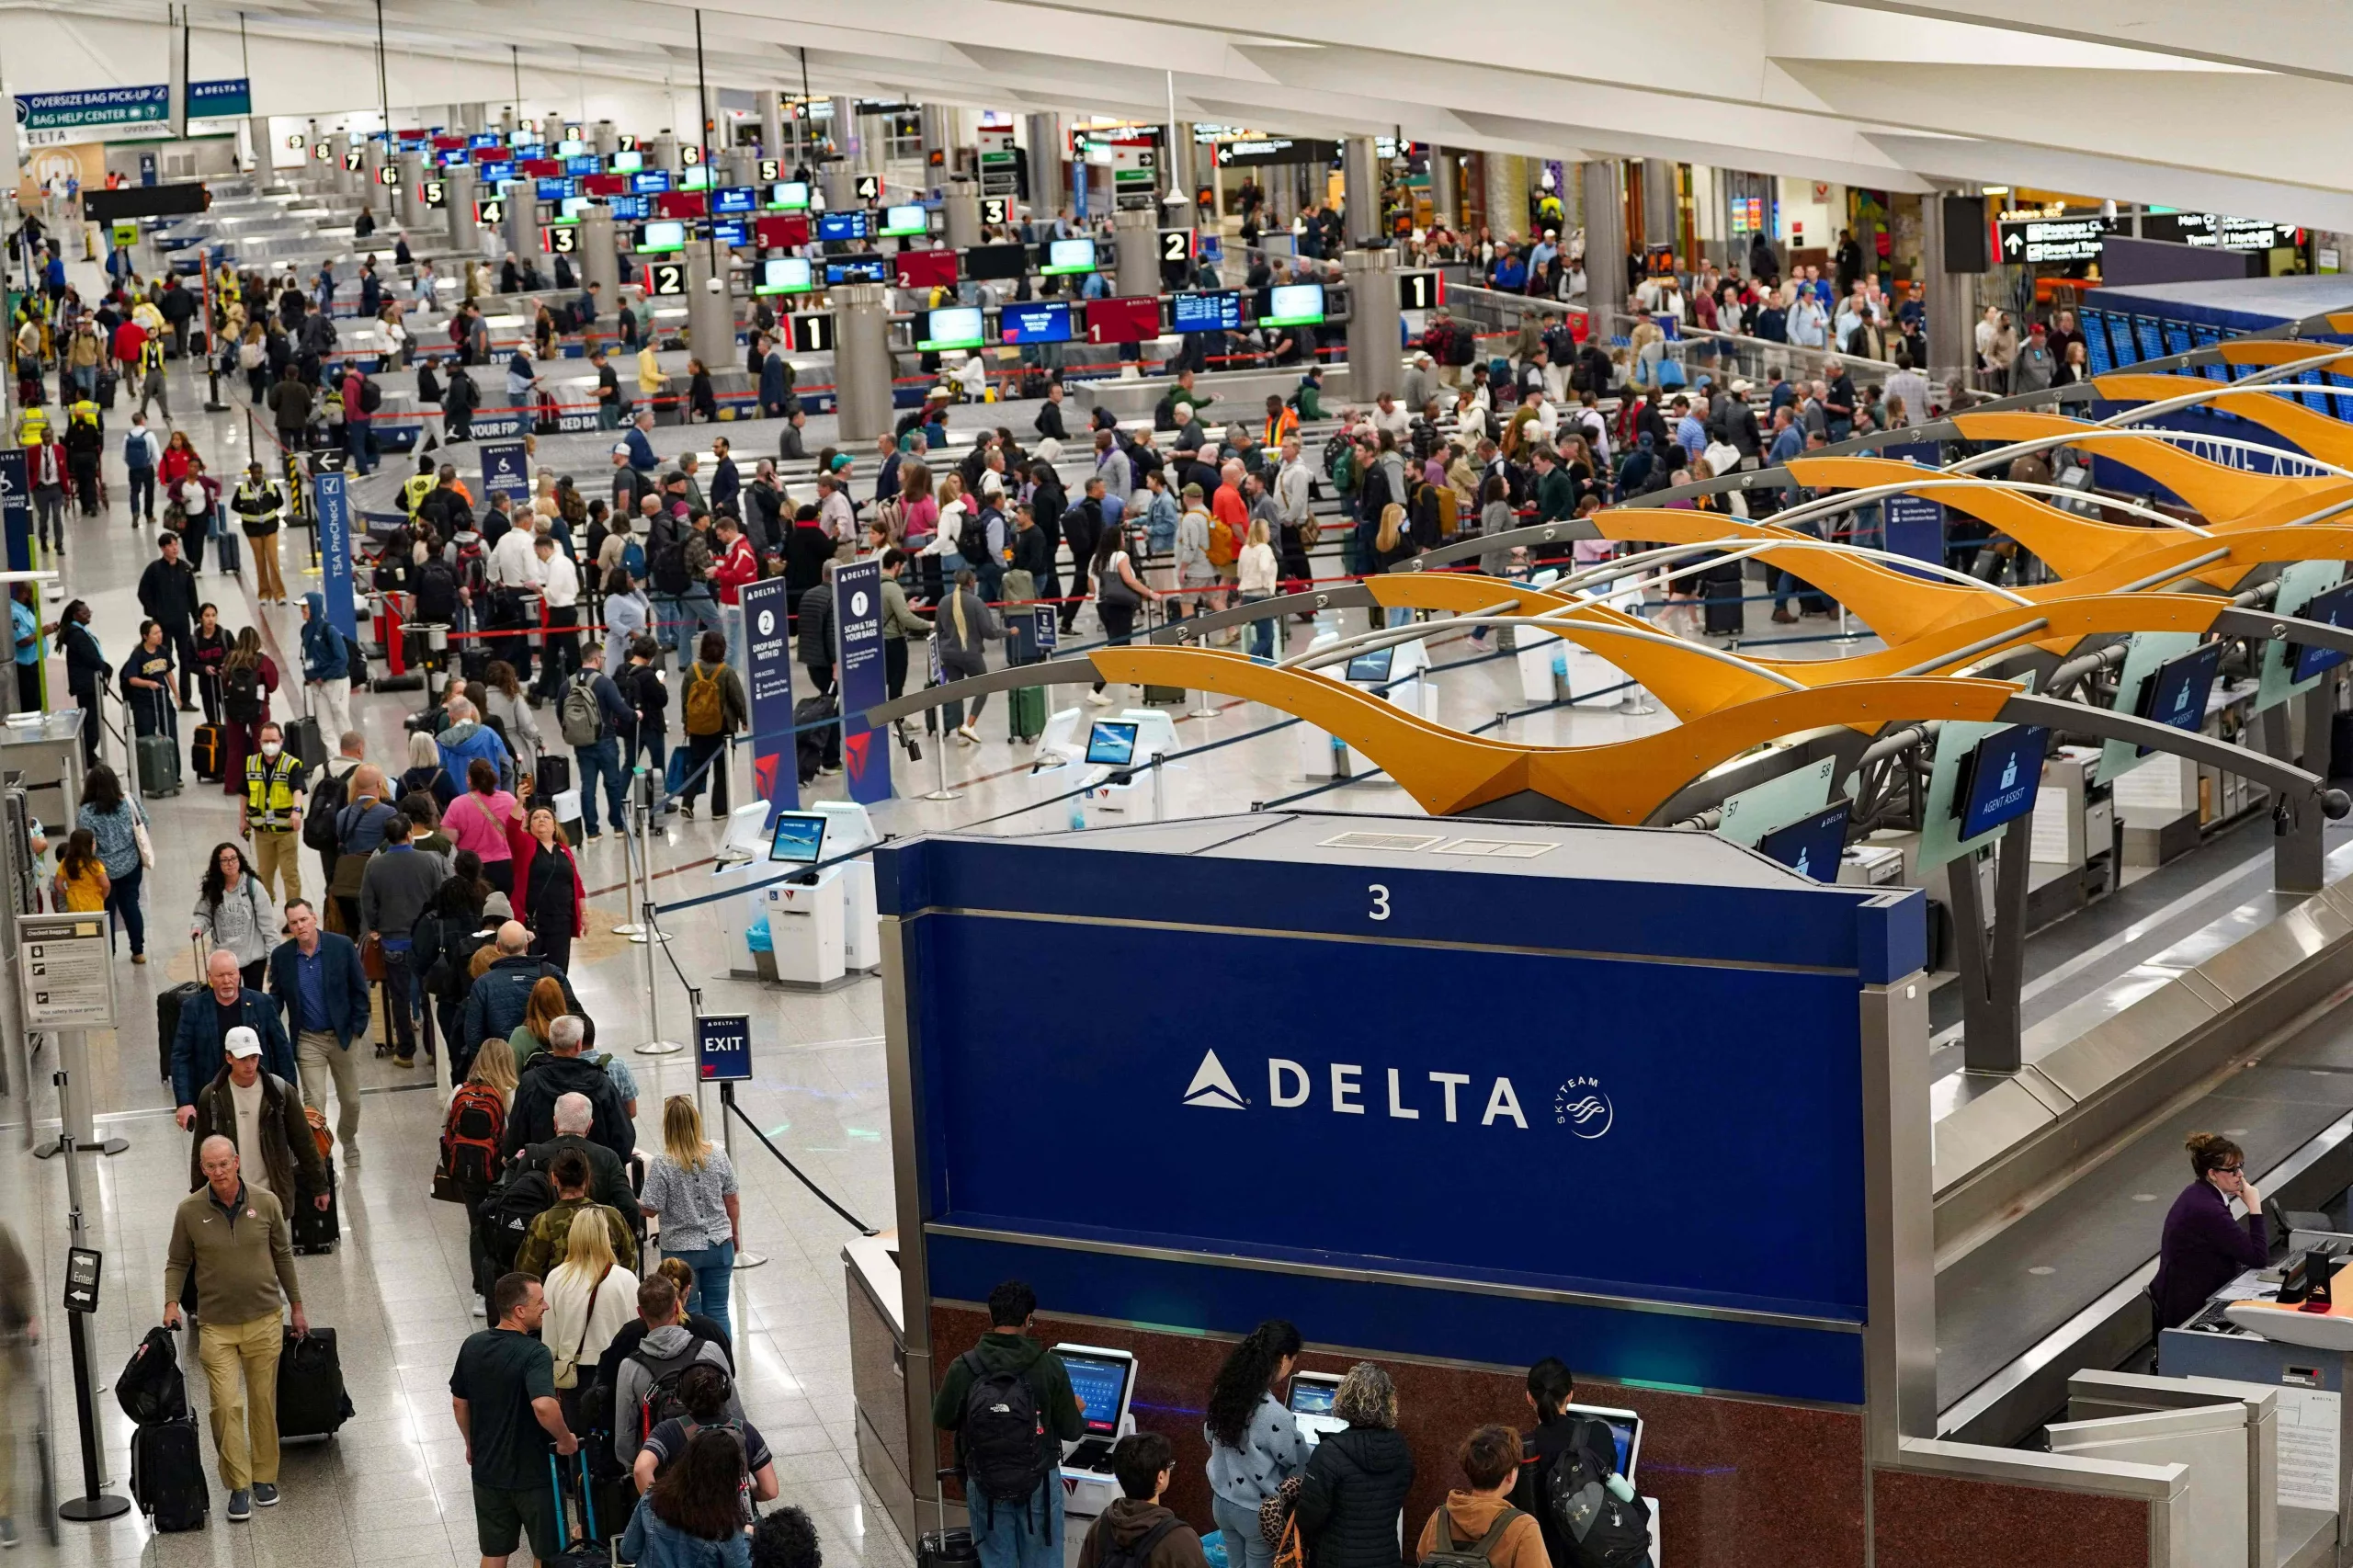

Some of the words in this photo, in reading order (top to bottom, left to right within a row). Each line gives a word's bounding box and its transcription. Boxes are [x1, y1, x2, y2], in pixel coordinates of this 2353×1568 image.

[204, 84, 237, 96] DELTA
[31, 93, 83, 109] OVERSIZE
[84, 91, 108, 106] BAG
[108, 89, 152, 105] PICK-UP
[32, 113, 55, 126] BAG
[57, 112, 84, 124] HELP
[85, 109, 127, 122] CENTER
[28, 131, 67, 145] ELTA
[290, 135, 302, 148] 9
[567, 127, 580, 141] 8
[317, 144, 329, 158] 8
[622, 135, 634, 152] 7
[347, 153, 360, 170] 7
[683, 147, 699, 165] 6
[381, 166, 398, 184] 6
[762, 161, 778, 181] 5
[427, 183, 442, 203] 5
[858, 176, 877, 199] 4
[483, 201, 502, 222] 4
[986, 200, 1003, 225] 3
[555, 228, 574, 252] 3
[758, 233, 768, 248] 3
[1165, 233, 1186, 262] 2
[659, 267, 680, 294] 2
[899, 271, 911, 288] 2
[1412, 276, 1426, 308] 1
[807, 317, 823, 350] 1
[1091, 324, 1101, 342] 1
[470, 422, 501, 437] YOUR
[327, 499, 342, 553] PreCheck
[334, 554, 344, 578] TSA
[847, 568, 870, 581] DELTA
[754, 586, 776, 598] DELTA
[763, 615, 770, 631] 2
[844, 622, 860, 634] SCAN
[864, 619, 878, 630] TAG
[845, 631, 861, 642] YOUR
[861, 628, 878, 639] BAGS
[752, 642, 767, 653] DROP
[767, 638, 782, 649] BAGS
[756, 650, 772, 661] WITH
[772, 648, 779, 657] ID
[1819, 763, 1832, 779] 58
[1726, 801, 1739, 818] 57
[1982, 794, 2005, 815] AGENT
[2004, 787, 2026, 807] ASSIST
[1825, 813, 1844, 825] DELTA
[1368, 883, 1391, 921] 3
[705, 1036, 744, 1052] EXIT
[1267, 1057, 1529, 1130] DELTA
[1554, 1075, 1598, 1124] SKYTEAM
[74, 1271, 94, 1286] Enter
